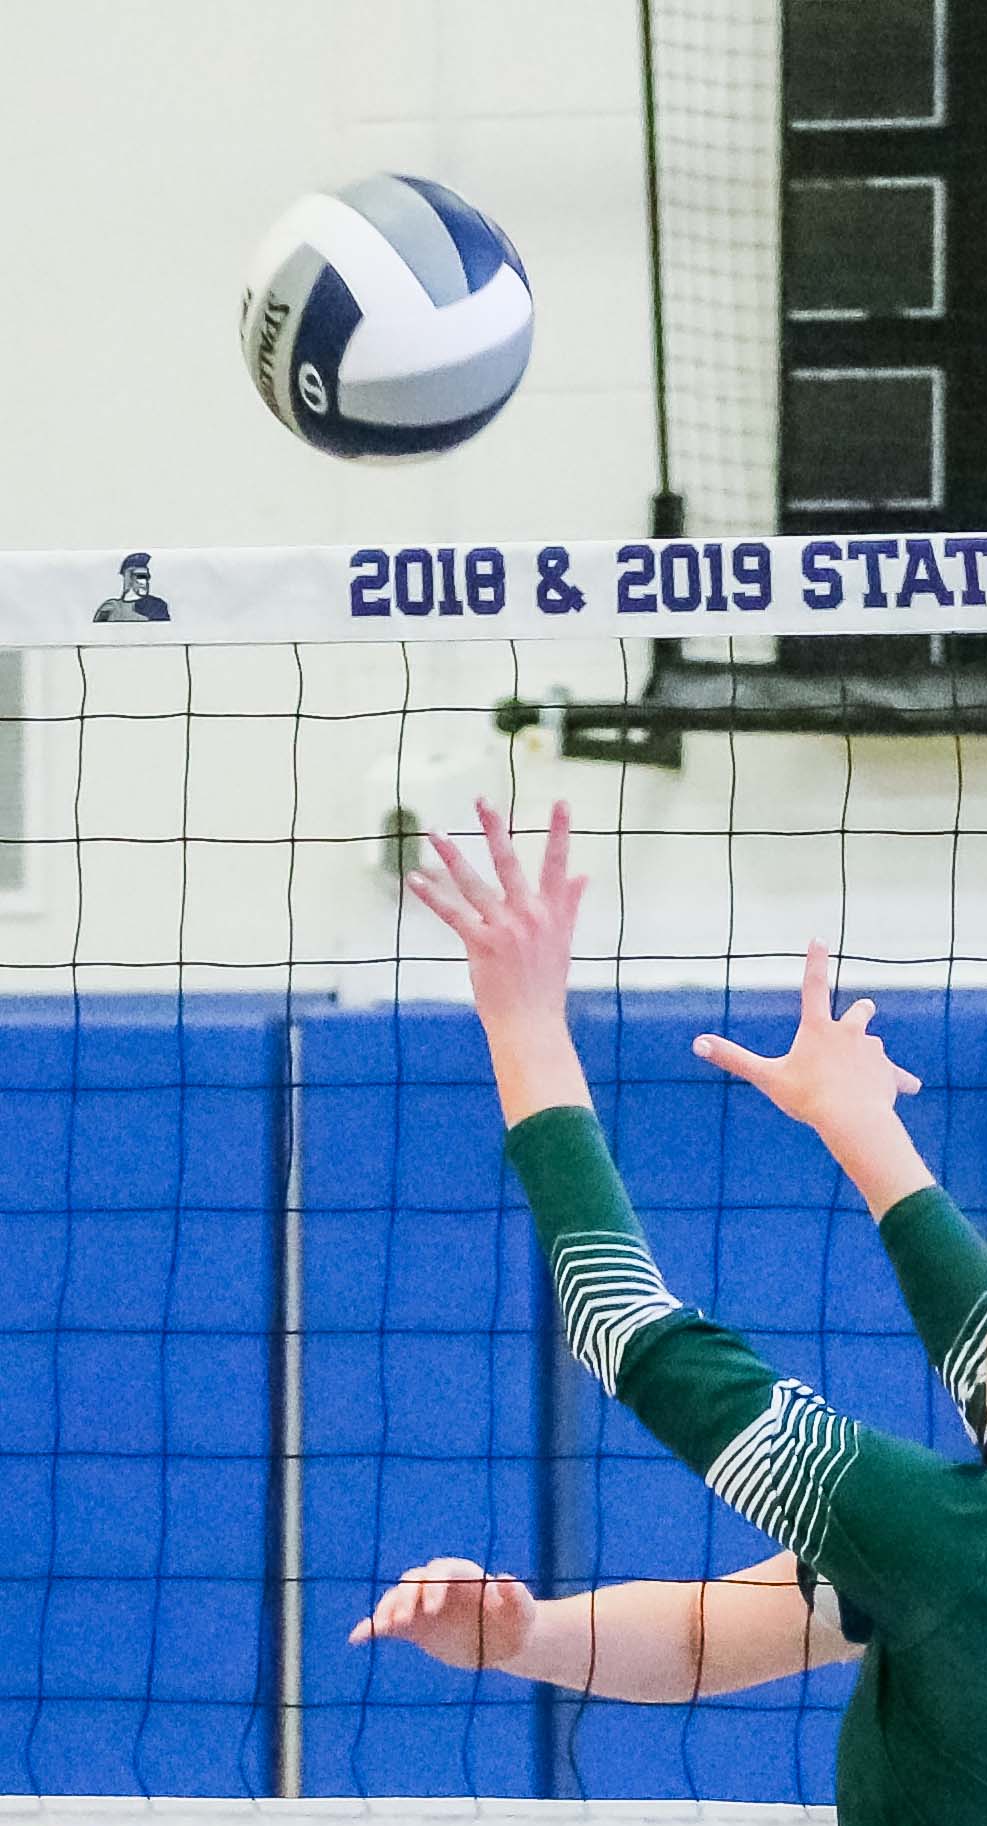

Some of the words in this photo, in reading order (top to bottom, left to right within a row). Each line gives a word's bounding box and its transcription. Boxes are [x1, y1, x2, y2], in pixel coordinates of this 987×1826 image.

[350, 547, 506, 617] 2018
[536, 546, 586, 615] &
[616, 542, 772, 613] 2019
